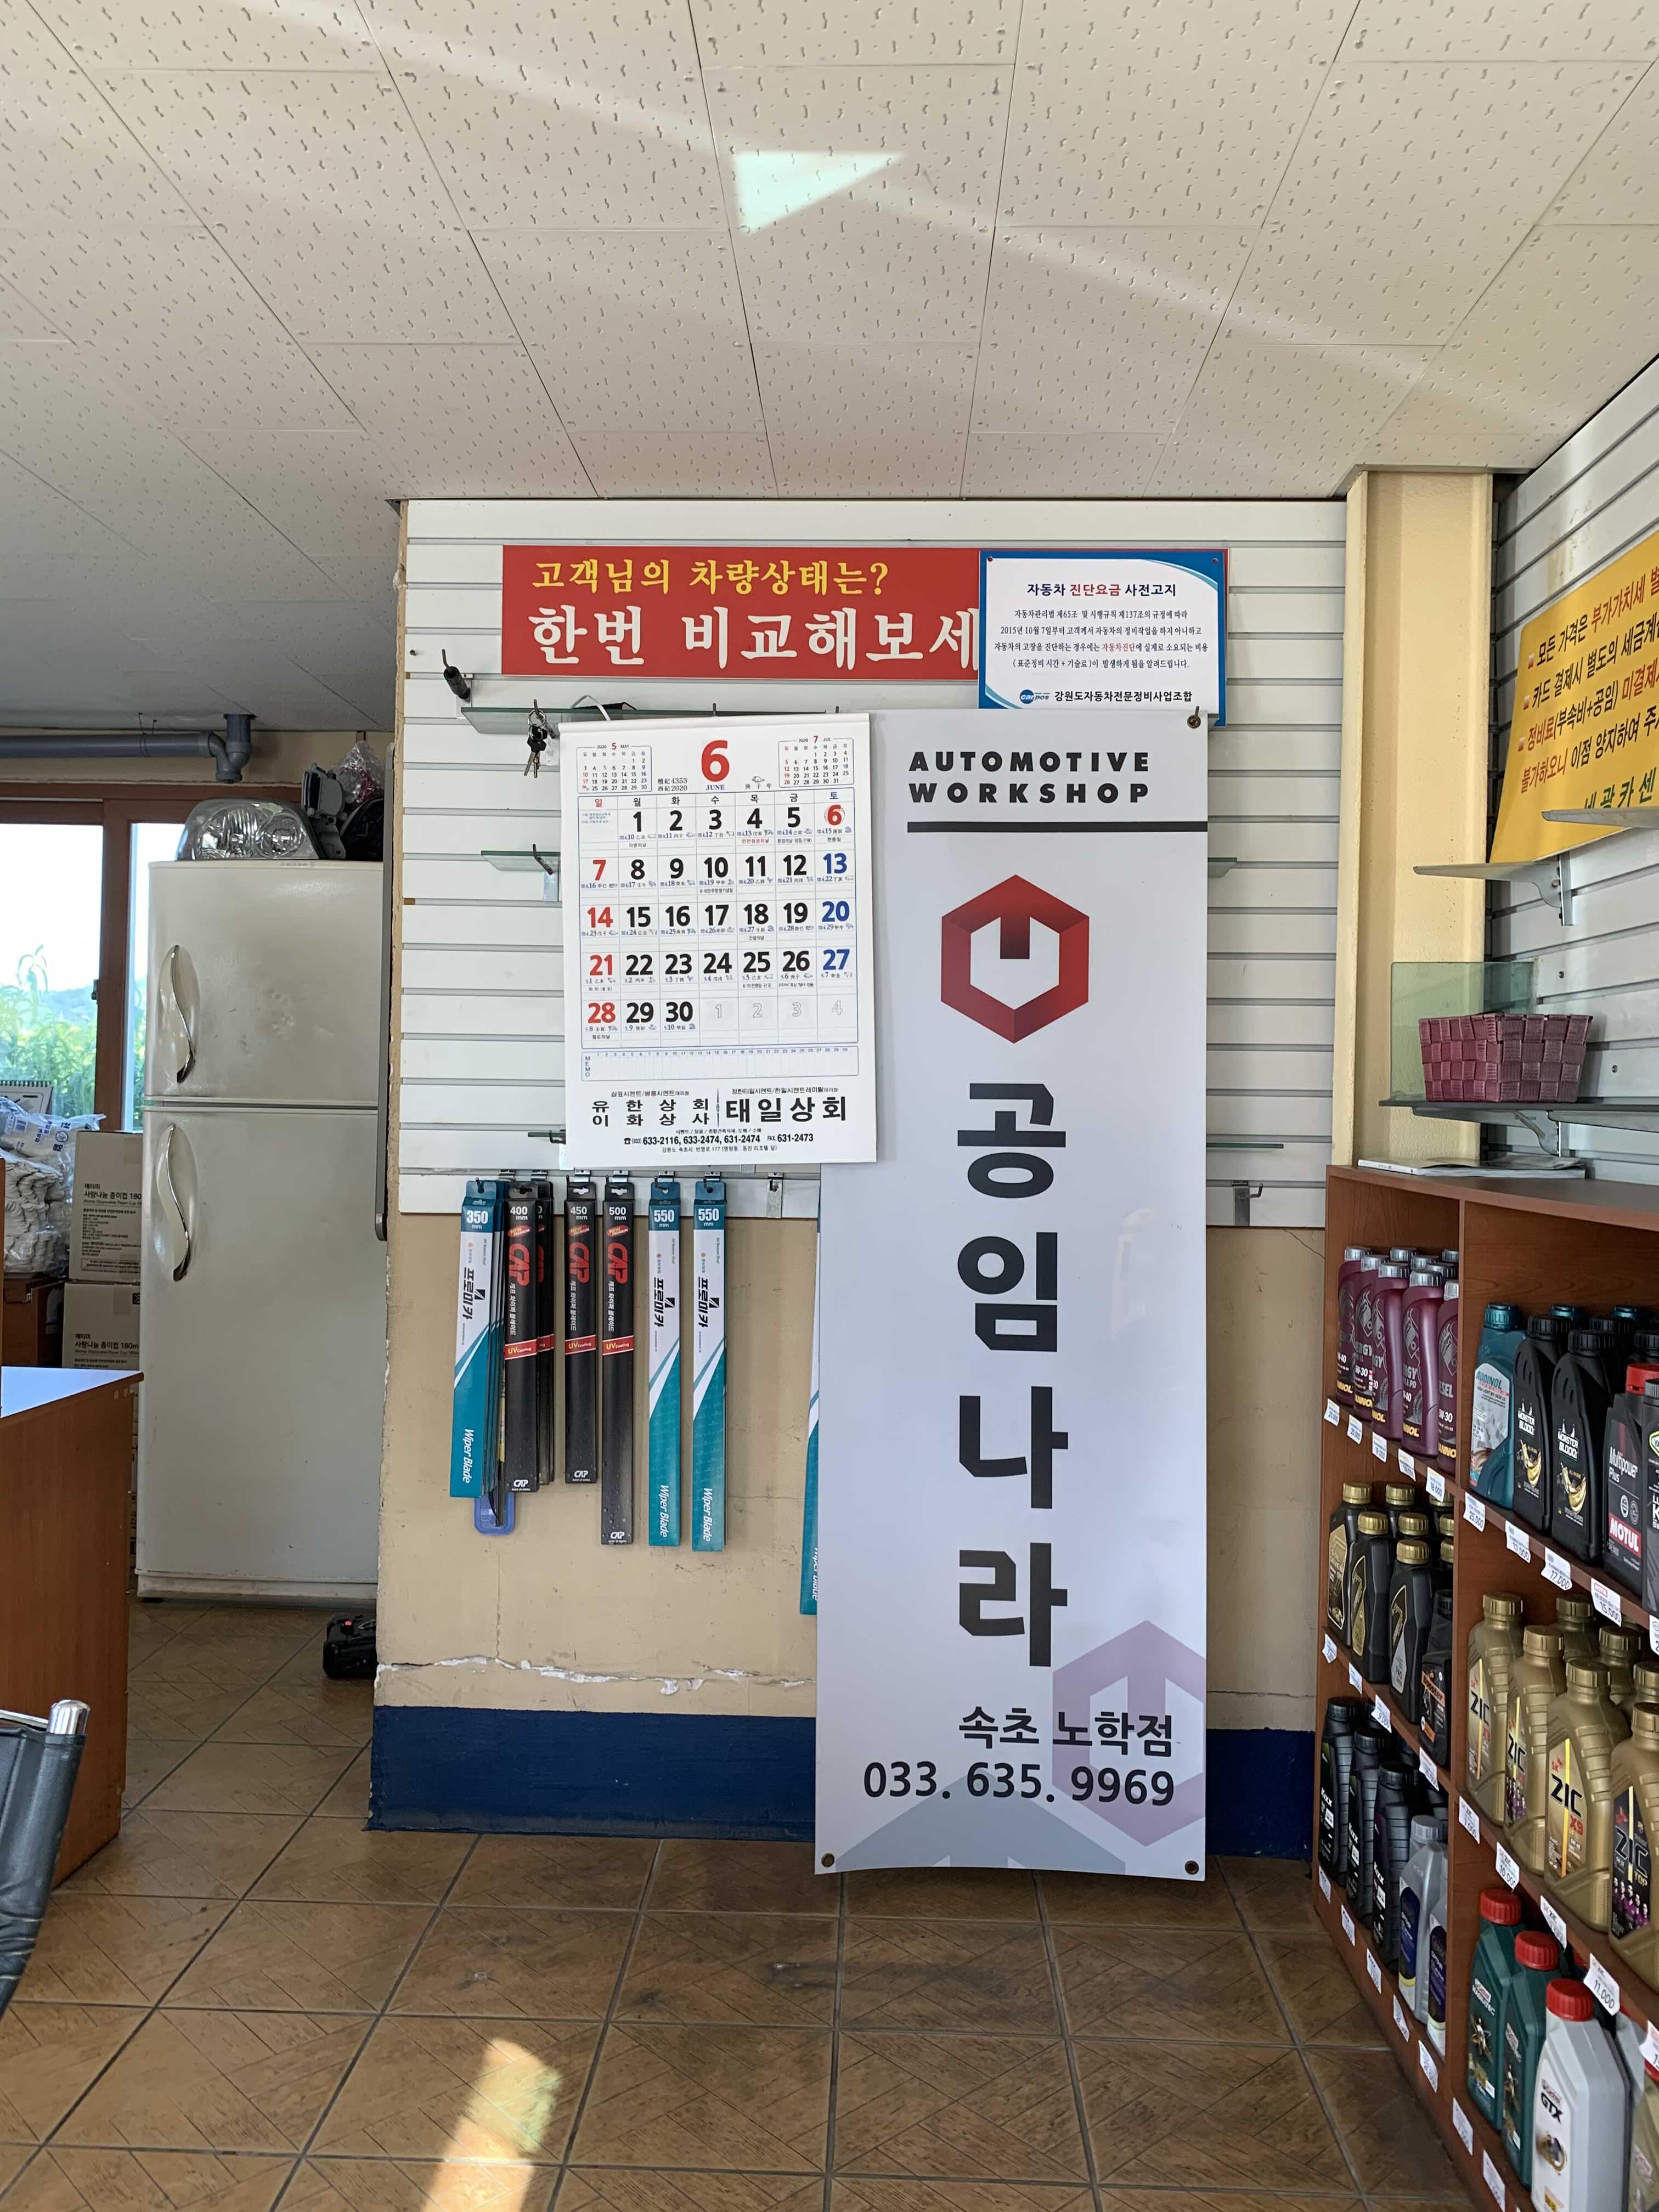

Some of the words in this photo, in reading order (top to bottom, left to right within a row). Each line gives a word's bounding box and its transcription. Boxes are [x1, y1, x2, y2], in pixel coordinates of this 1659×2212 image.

[532, 559, 670, 594] 고객님의
[690, 560, 888, 595] 차량상태는?
[1027, 583, 1065, 596] 자동차
[1070, 583, 1121, 596] 진단요금
[1125, 583, 1176, 596] 사전고지
[1014, 610, 1054, 619] 자동차관리법
[1057, 610, 1077, 619] 제65조
[1082, 610, 1087, 619] 및
[1090, 610, 1116, 619] 시행규칙
[1119, 610, 1150, 619] 제137조의
[1153, 610, 1172, 619] 규정에
[1175, 610, 1188, 619] 따라
[1537, 635, 1556, 667] 모든
[1559, 614, 1588, 652] 가격은
[1592, 573, 1646, 633] 부가가치세
[528, 605, 645, 665] 한번
[681, 606, 978, 670] 비교해보세
[1001, 627, 1023, 636] 2015년
[1025, 627, 1039, 636] 10월
[1042, 627, 1065, 636] 7일부터
[1067, 627, 1093, 636] 고객께서
[1096, 627, 1122, 636] 자동차의
[1125, 627, 1157, 636] 정비작업을
[1160, 627, 1172, 636] 하지
[1175, 627, 1201, 636] 아니하고
[994, 642, 1020, 652] 자동차의
[1023, 642, 1042, 652] 고장을
[1045, 642, 1071, 652] 진단하는
[1074, 642, 1099, 652] 경우에는
[1102, 642, 1142, 652] 자동차진단에
[1144, 642, 1164, 652] 실제로
[1166, 642, 1193, 652] 소요되는
[1195, 642, 1208, 652] 비용
[1532, 679, 1551, 708] 카드
[1554, 657, 1583, 697] 결제시
[1587, 635, 1618, 679] 별도의
[1621, 612, 1659, 656] 세금계
[1046, 659, 1059, 669] 시간
[1102, 659, 1129, 669] 발생하게
[1147, 659, 1189, 669] 알려드립니다.
[1054, 691, 1192, 702] 강원도자동차전문정비사업조합
[1527, 680, 1618, 751] 정비료(부속비+공임)
[701, 740, 730, 782] 6
[908, 751, 1149, 773] AUTOMOTIVE
[1521, 748, 1568, 794] 불가하오니
[1571, 736, 1592, 769] 이점
[1595, 712, 1640, 759] 양지하여
[595, 798, 602, 808] 일
[633, 798, 641, 807] 월
[672, 797, 680, 805] 화
[711, 796, 719, 804] 수
[751, 794, 759, 803] 목
[790, 794, 798, 802] 금
[908, 782, 1149, 804] WORKSHOP
[633, 811, 642, 832] 1
[669, 810, 682, 831] 2
[709, 809, 722, 830] 3
[747, 808, 763, 828] 4
[788, 806, 801, 827] 5
[827, 804, 842, 826] 6
[592, 860, 606, 881] 7
[631, 859, 645, 880] 8
[669, 858, 684, 879] 9
[703, 857, 729, 878] 10
[745, 856, 766, 877] 11
[783, 855, 807, 876] 12
[823, 853, 847, 874] 13
[588, 907, 613, 928] 14
[626, 906, 651, 927] 15
[665, 906, 690, 927] 16
[704, 905, 729, 926] 17
[744, 904, 769, 925] 18
[783, 902, 808, 924] 19
[822, 901, 850, 922] 20
[590, 955, 613, 975] 21
[626, 955, 653, 975] 22
[665, 953, 692, 975] 23
[703, 952, 732, 974] 24
[743, 951, 770, 973] 25
[782, 950, 810, 972] 26
[823, 949, 850, 970] 27
[588, 1002, 616, 1023] 28
[627, 1002, 654, 1023] 29
[665, 1001, 693, 1022] 30
[726, 1096, 845, 1123] 태일상회
[724, 1135, 760, 1143] 631-2474
[777, 1133, 813, 1142] 631-2473
[466, 1210, 488, 1224] 350
[510, 1206, 527, 1215] 400
[571, 1206, 587, 1215] 450
[609, 1207, 626, 1215] 500
[654, 1210, 675, 1222] 550
[698, 1208, 719, 1221] 550
[509, 1243, 531, 1286] CAP
[569, 1242, 589, 1283] CAP
[607, 1242, 628, 1284] CAP
[957, 1082, 1069, 1667] 공임나라
[1476, 1370, 1502, 1390] ADDINOL
[1518, 1409, 1535, 1426] MONSTER
[462, 1429, 474, 1459] Wiper
[1558, 1431, 1578, 1447] MONSTER
[462, 1459, 473, 1483] Blade
[1609, 1466, 1620, 1482] Plus
[1610, 1447, 1638, 1479] Multipower
[658, 1485, 669, 1511] Wiper
[702, 1488, 713, 1515] Wiper
[660, 1512, 669, 1537] Blade
[703, 1516, 713, 1542] Blade
[1610, 1517, 1639, 1552] MOTUL
[959, 1706, 1039, 1749] 속초
[1053, 1711, 1172, 1757] 노학점
[864, 1761, 950, 1799] 033.
[967, 1762, 1054, 1803] 635.
[1071, 1765, 1175, 1806] 9969
[1550, 1773, 1583, 1818] ZIC
[1615, 1825, 1649, 1878] ZIC
[1634, 1871, 1647, 1887] TOP
[1541, 2092, 1563, 2123] GTX
